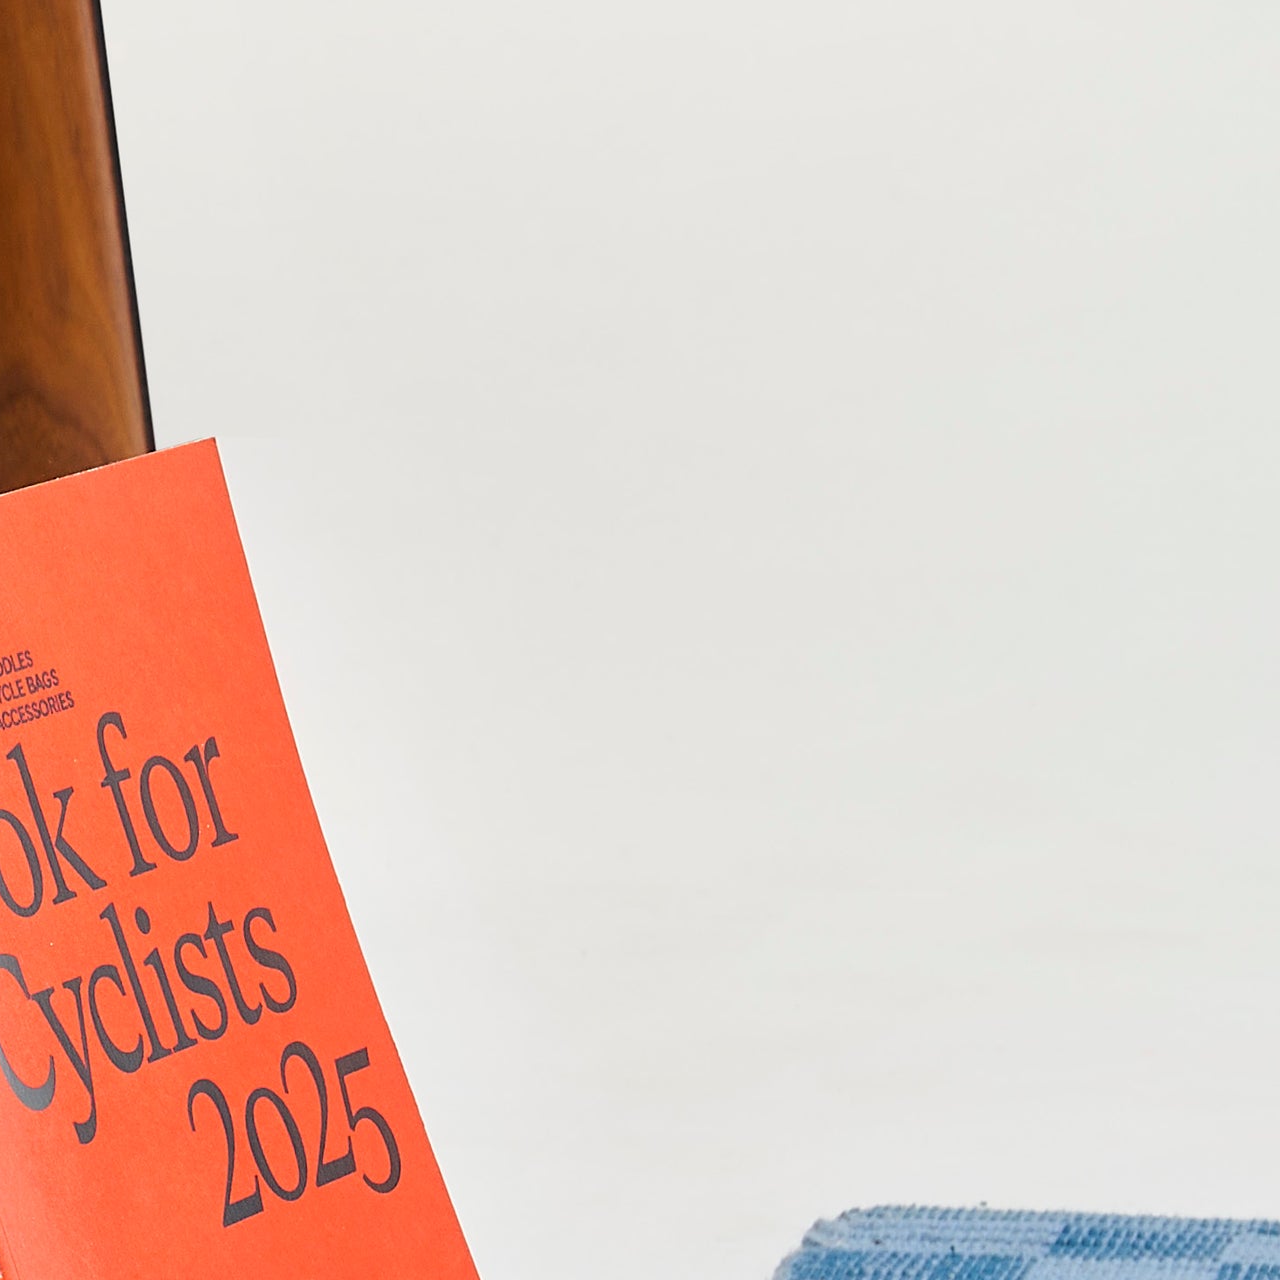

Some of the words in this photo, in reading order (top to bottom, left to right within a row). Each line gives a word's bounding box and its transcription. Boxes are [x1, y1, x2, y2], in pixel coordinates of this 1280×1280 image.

[25, 668, 60, 695] BAGS
[96, 711, 240, 878] for
[186, 1040, 403, 1229] 2025
